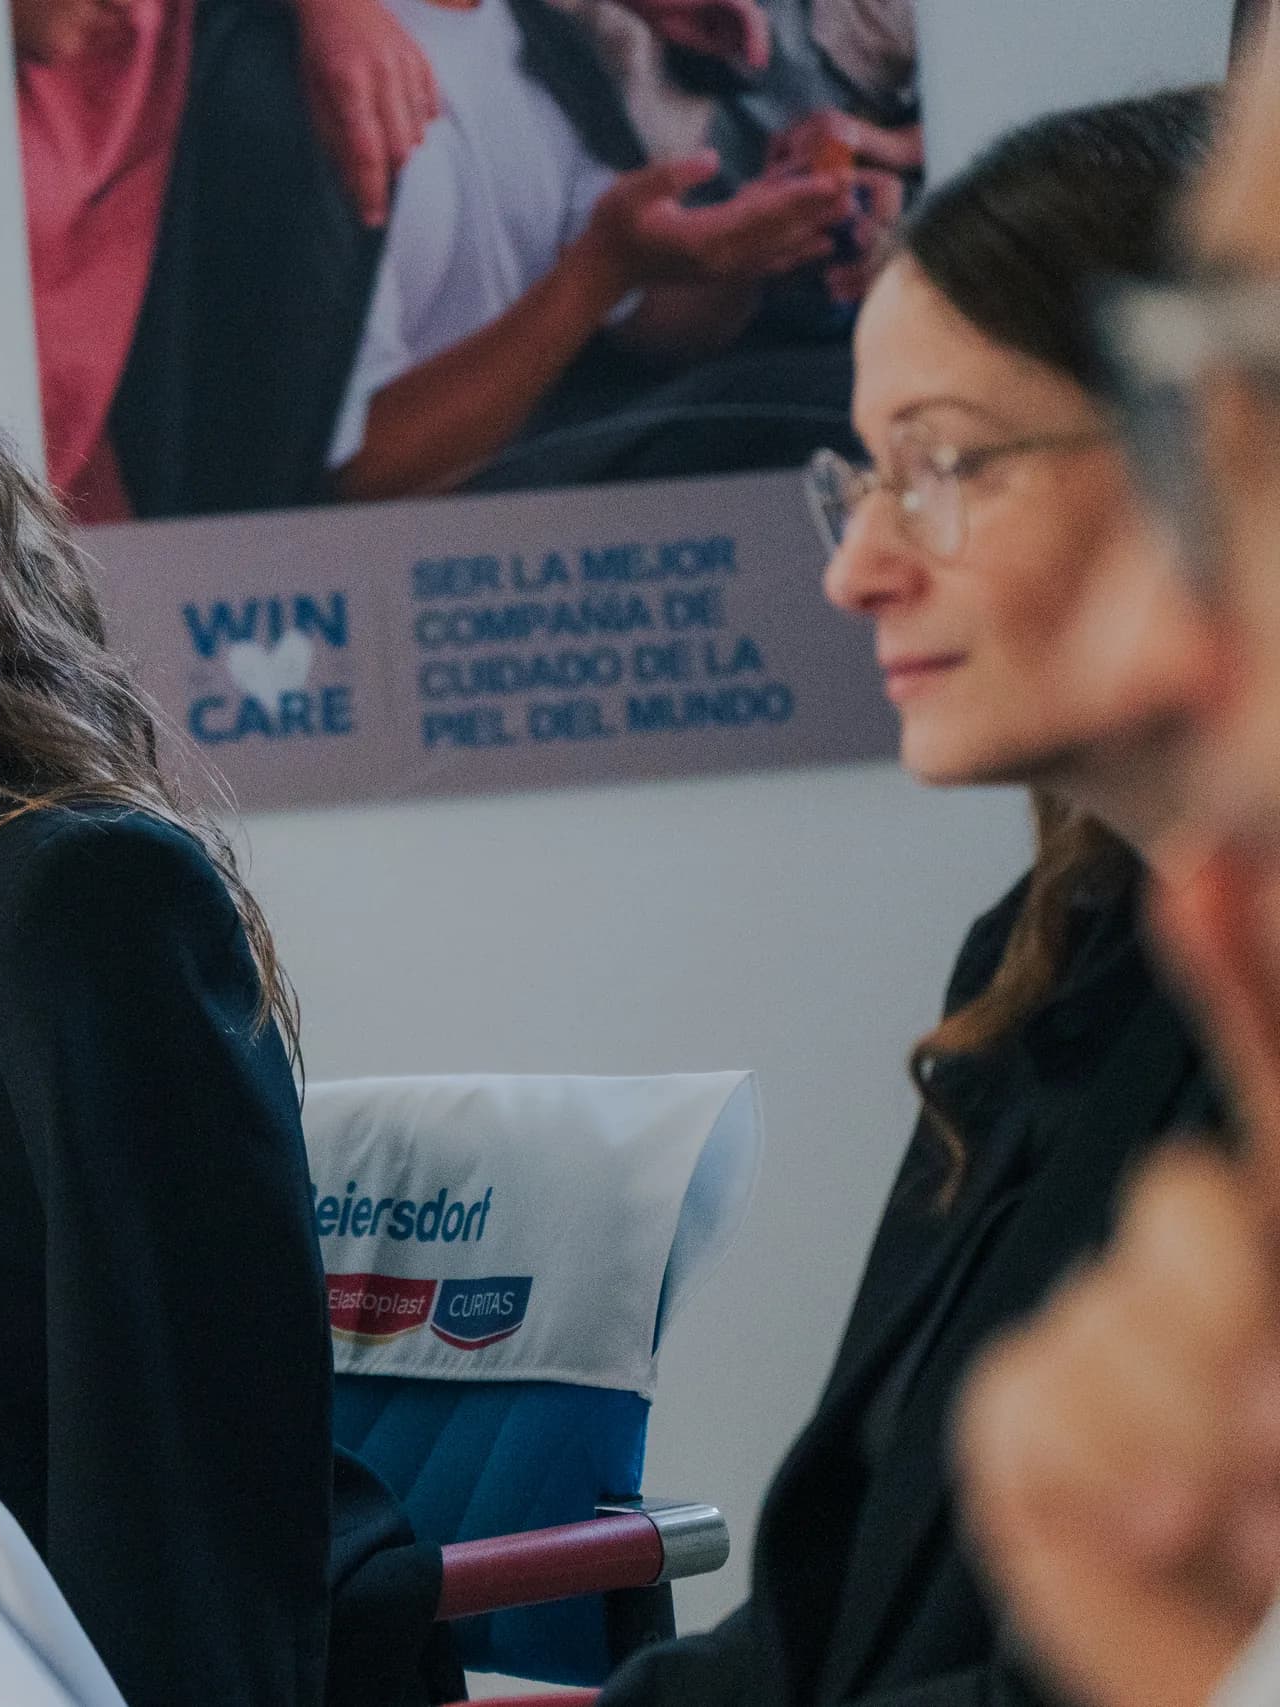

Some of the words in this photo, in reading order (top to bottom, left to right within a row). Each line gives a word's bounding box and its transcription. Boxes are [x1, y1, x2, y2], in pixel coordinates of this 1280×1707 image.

[413, 555, 501, 598] SER
[511, 551, 570, 591] LA
[580, 536, 735, 583] MEJOR
[183, 591, 349, 658] WIN
[664, 588, 723, 630] DE
[418, 645, 623, 698] CUIDADO
[633, 639, 694, 681] DE
[703, 633, 763, 676] LA
[187, 685, 353, 744] CARE
[422, 707, 517, 748] PIEL
[528, 700, 617, 740] DEL
[627, 683, 794, 731] MUNDO
[311, 1180, 493, 1243] eiersdorf
[327, 1289, 425, 1318] Elastoplast
[449, 1291, 515, 1318] CURITAS
